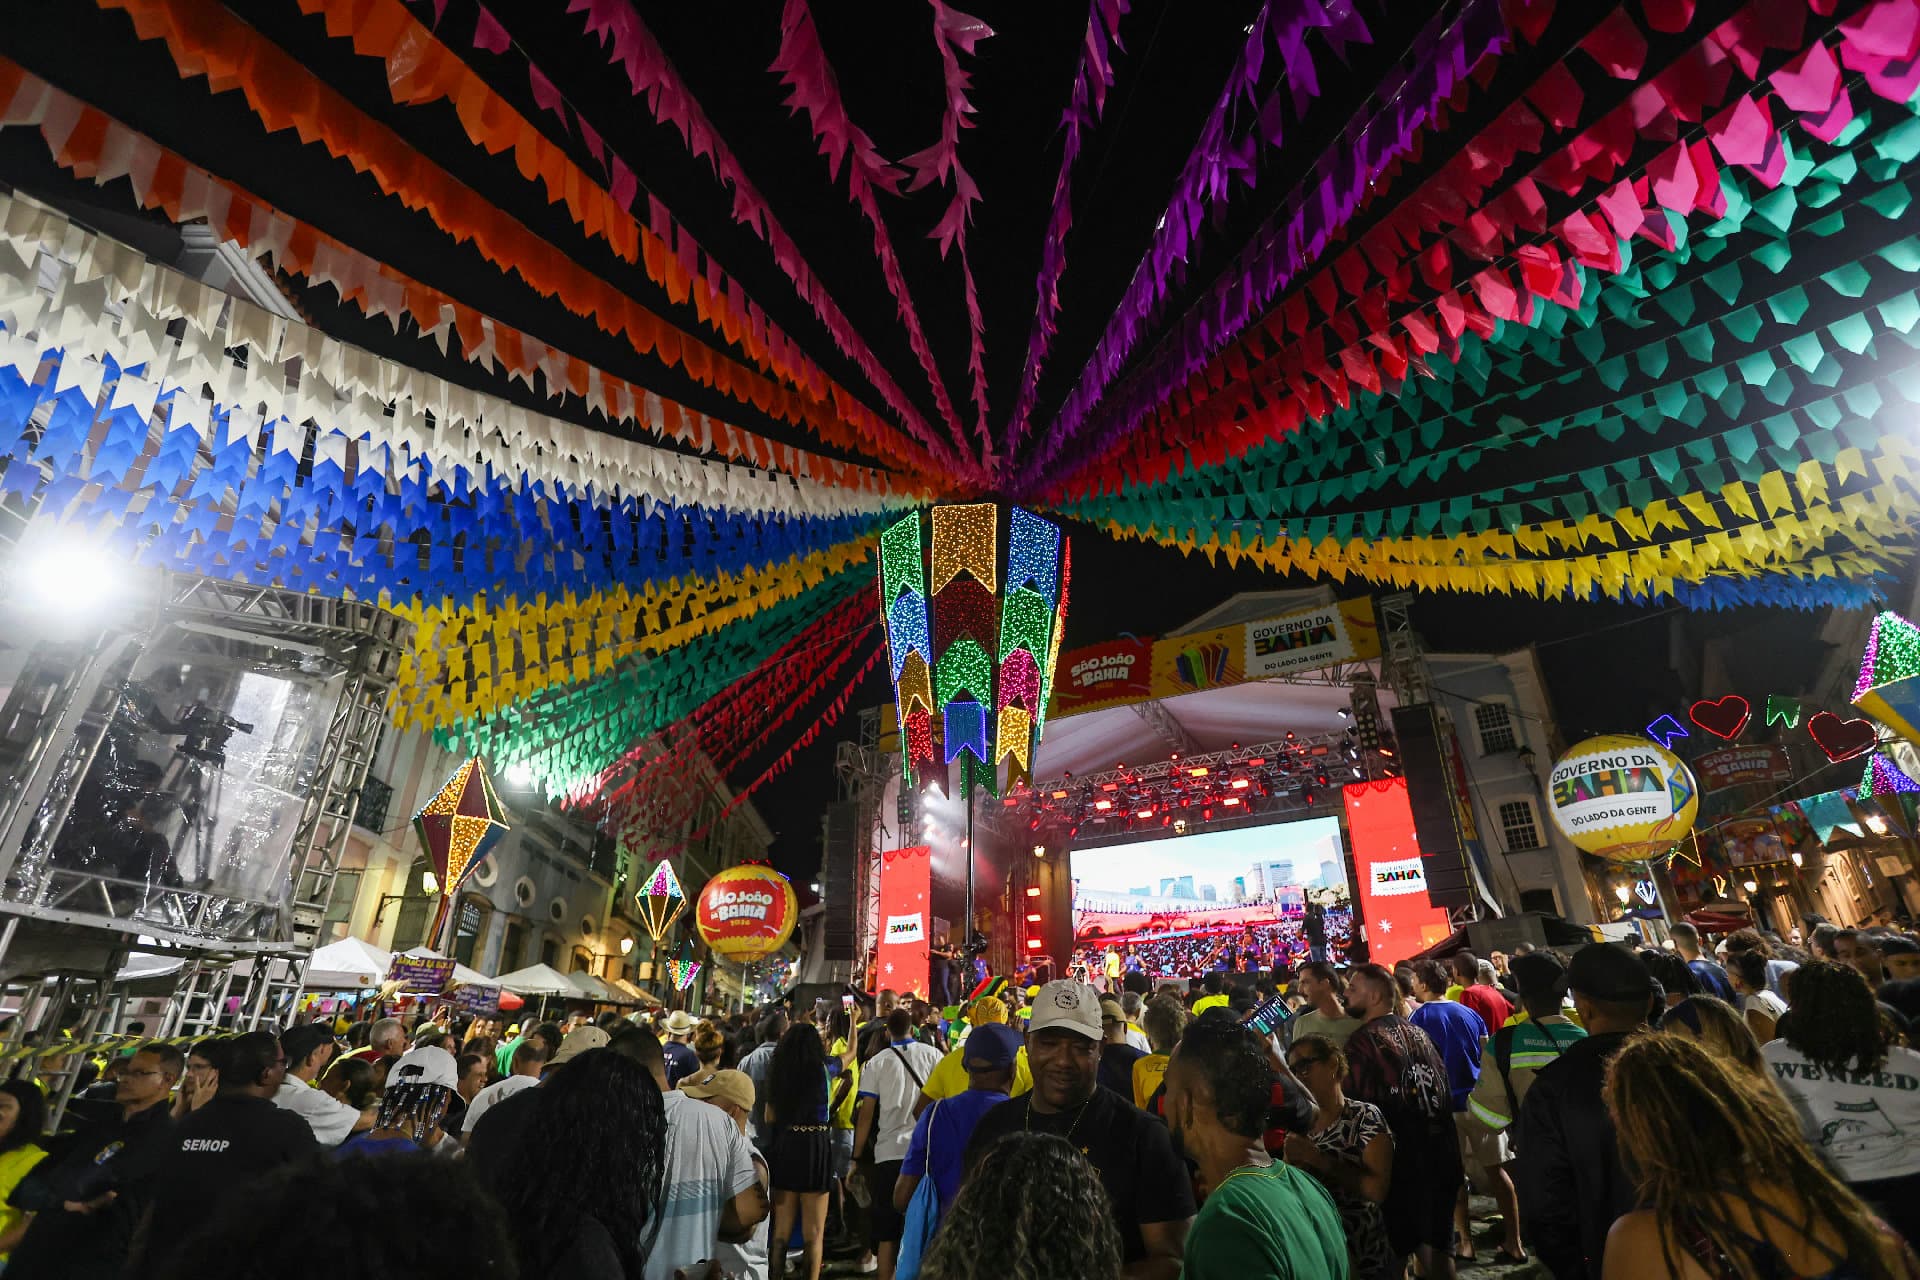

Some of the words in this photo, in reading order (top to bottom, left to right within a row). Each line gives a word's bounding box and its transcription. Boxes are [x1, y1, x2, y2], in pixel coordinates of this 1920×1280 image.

[1253, 618, 1312, 639] GOVERNO
[1316, 615, 1333, 625] DA
[1254, 624, 1337, 656] BAHIA
[1264, 662, 1277, 670] DO
[1277, 658, 1298, 668] LADO
[1298, 655, 1309, 663] DA
[1309, 651, 1333, 661] GENTE
[1081, 666, 1129, 687] BAHIA
[1552, 756, 1627, 783] GOVERNO
[1631, 755, 1658, 766] DA
[1717, 759, 1769, 775] BAHIA
[1553, 767, 1665, 808] BAHIA
[1571, 816, 1584, 826] DO
[1584, 811, 1609, 823] LADO
[1610, 808, 1626, 818] DA
[1626, 806, 1657, 816] GENTE
[1376, 869, 1421, 883] BAHIA
[718, 904, 767, 922] BAHIA
[890, 922, 919, 934] BAHIA
[1771, 1062, 1821, 1080] WE
[182, 1139, 230, 1152] SEMOP
